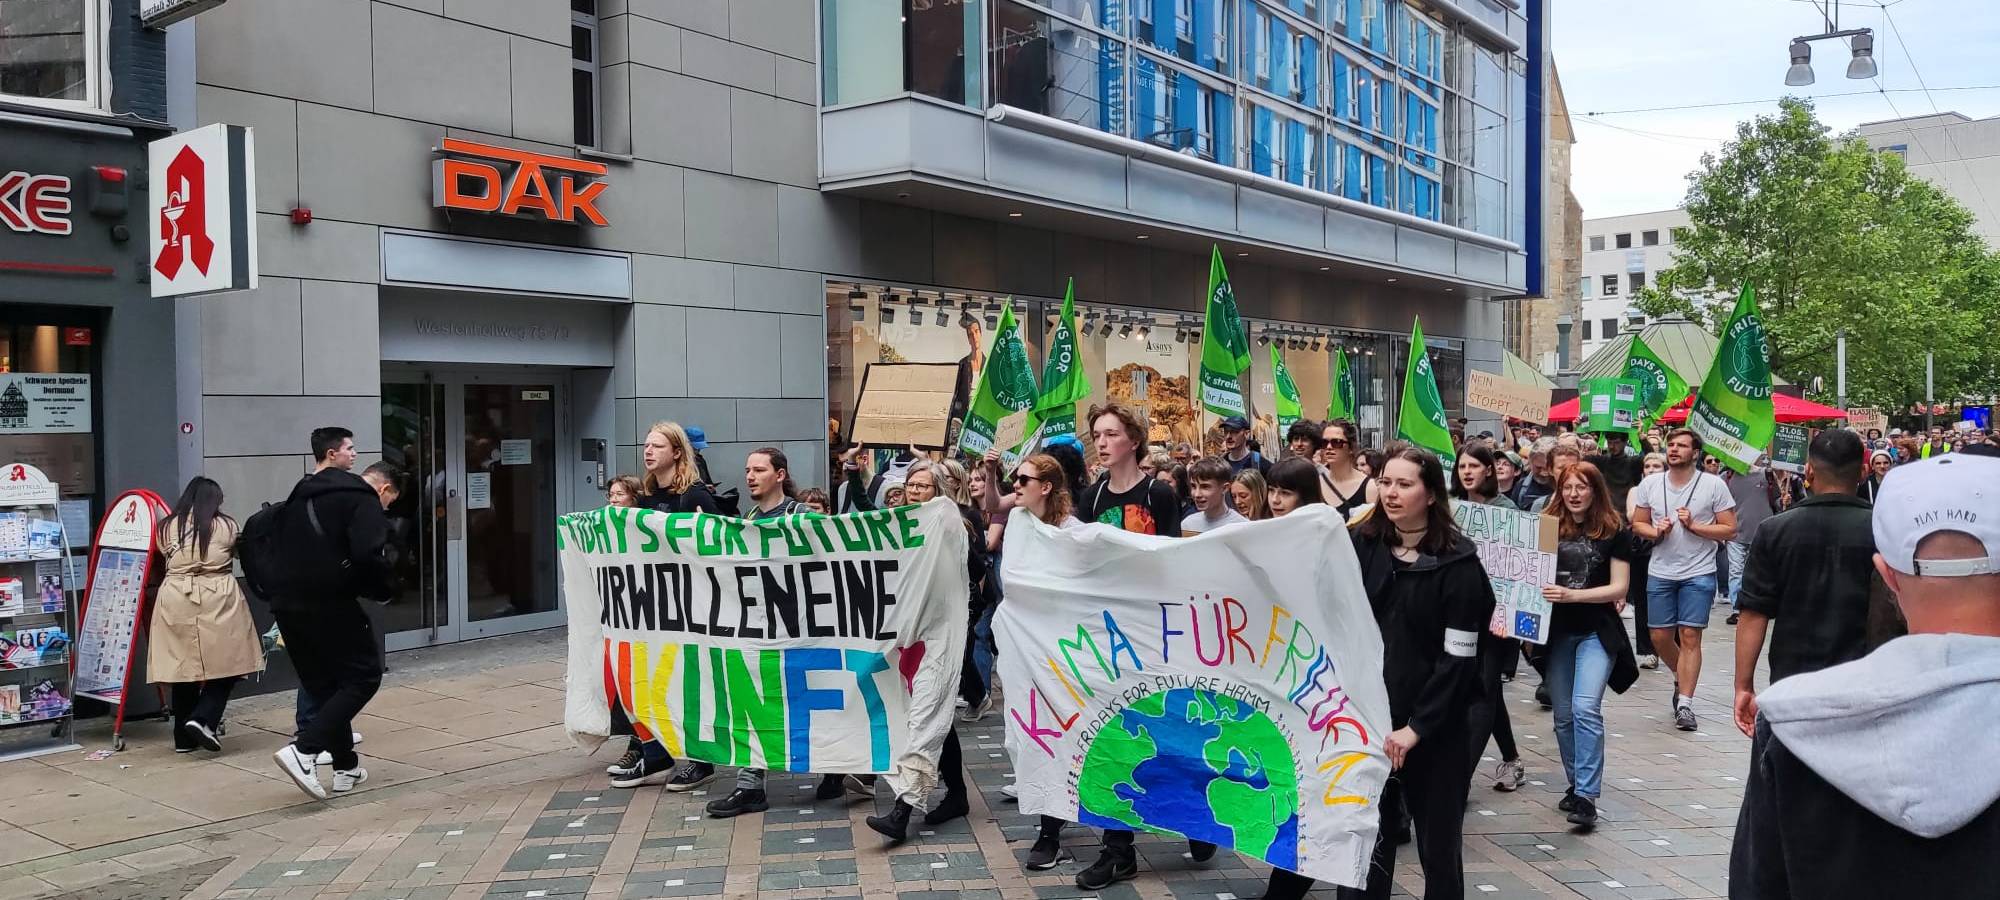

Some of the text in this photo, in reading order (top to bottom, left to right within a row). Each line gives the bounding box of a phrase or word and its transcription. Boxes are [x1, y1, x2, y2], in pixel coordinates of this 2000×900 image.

[440, 137, 610, 228] DAK
[1472, 374, 1493, 387] NEIN
[1654, 370, 1667, 389] FOR
[1469, 392, 1511, 411] STOPPT
[665, 511, 749, 556] FOR
[760, 503, 925, 558] FUTURE
[1914, 509, 1977, 526] PLAY HARD
[1011, 610, 1143, 758] KLIMA
[1159, 594, 1255, 667] FÜR
[1077, 674, 1271, 752] FRIDAYS FOR FUTURE HAMM
